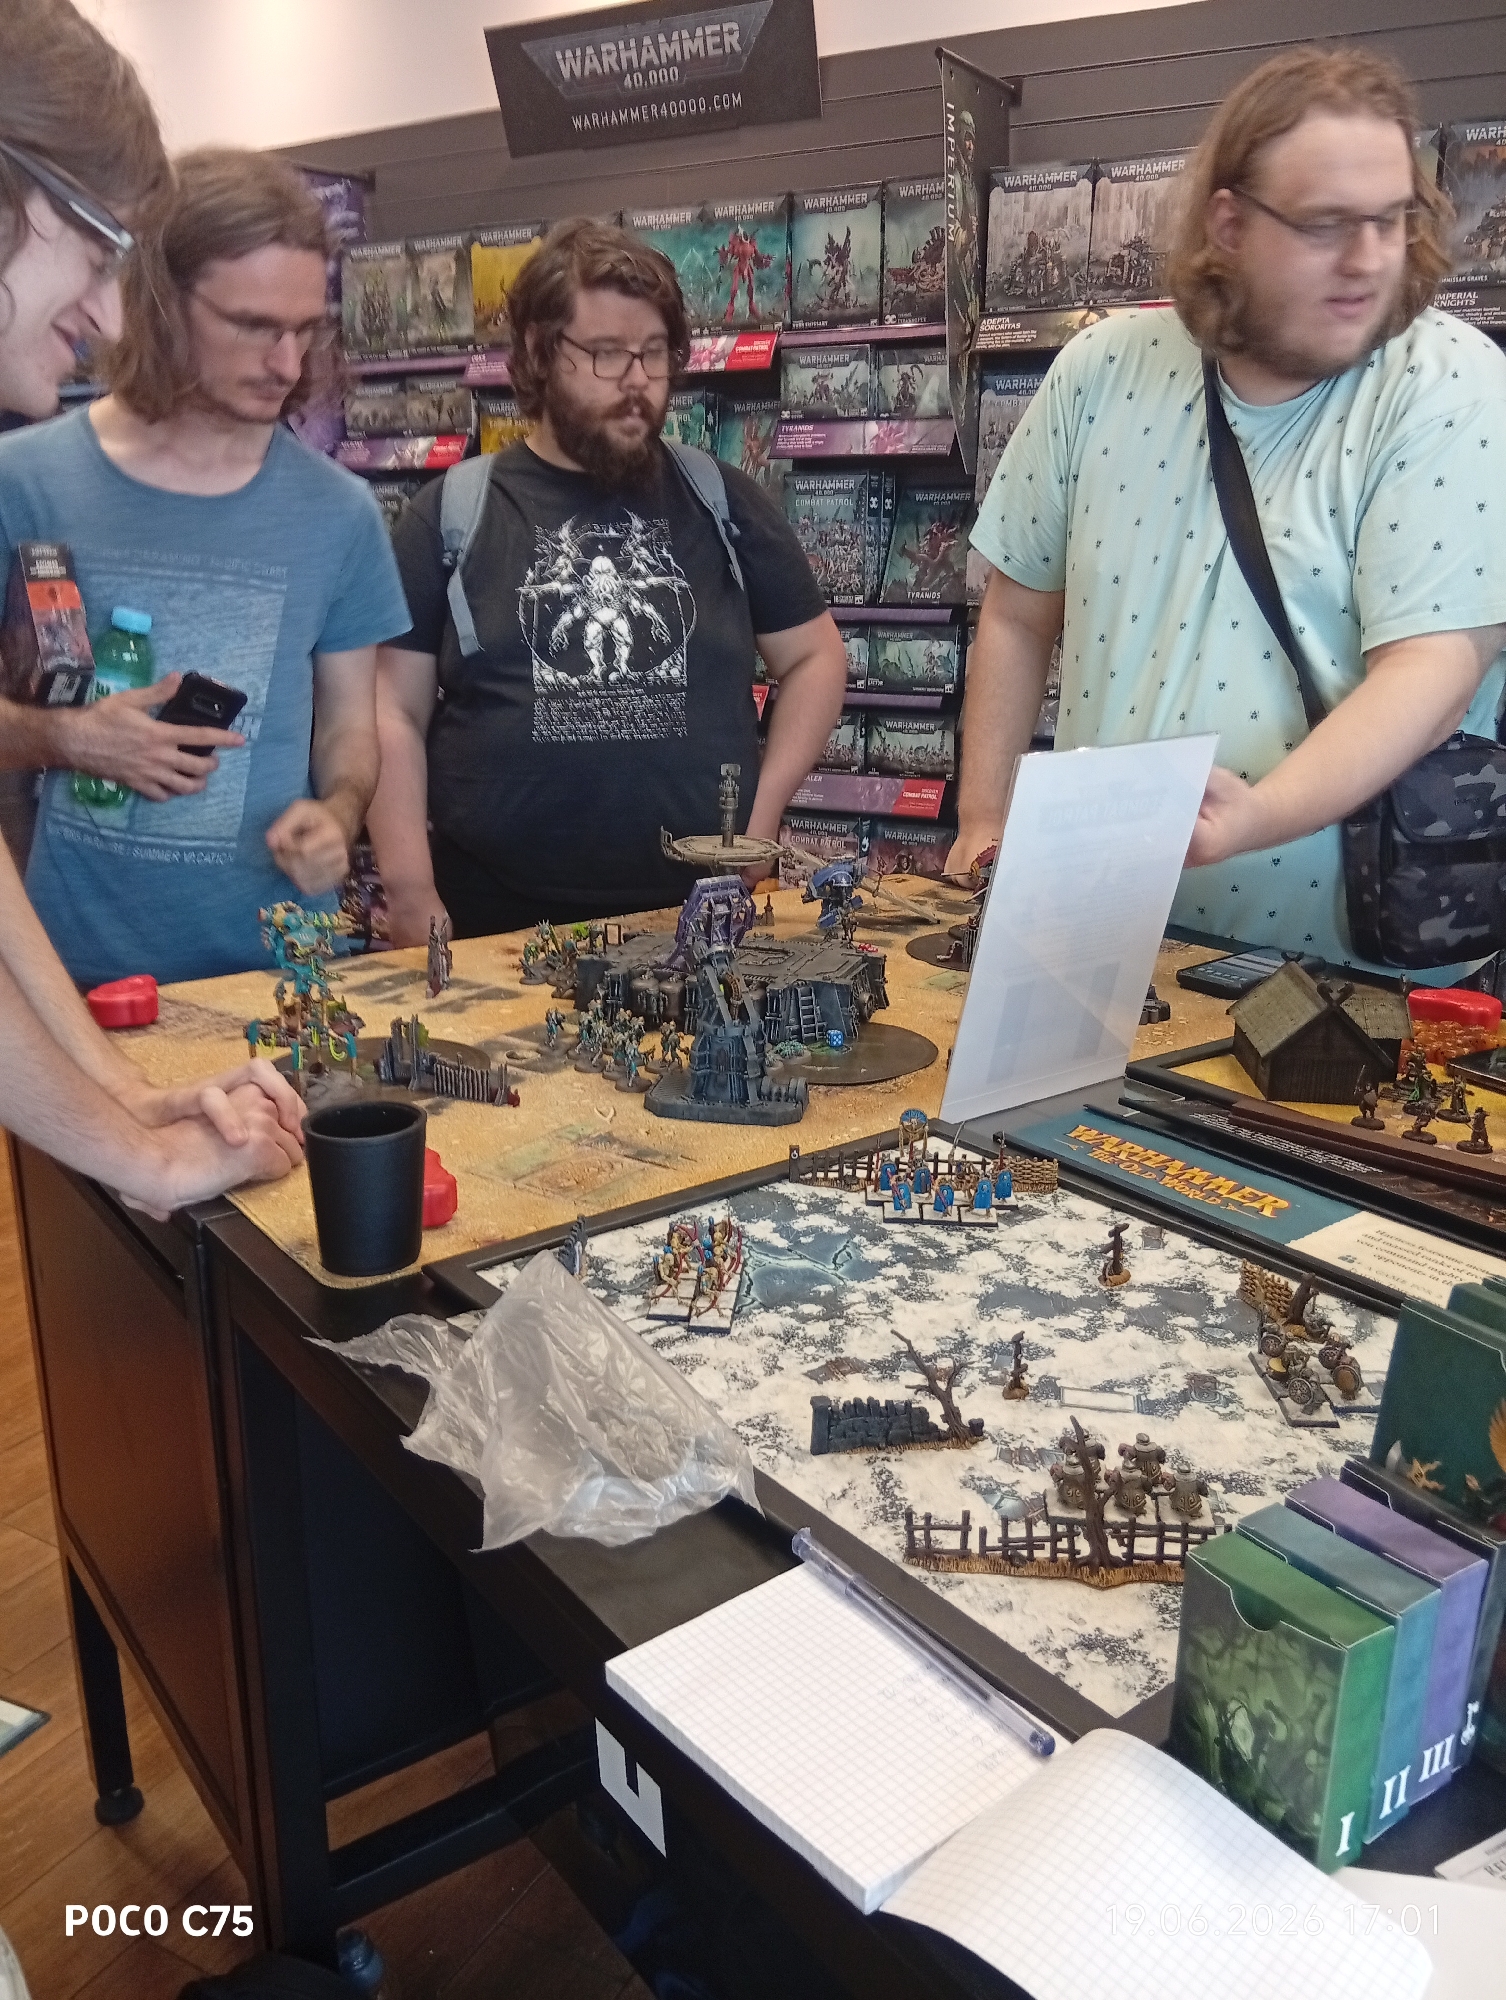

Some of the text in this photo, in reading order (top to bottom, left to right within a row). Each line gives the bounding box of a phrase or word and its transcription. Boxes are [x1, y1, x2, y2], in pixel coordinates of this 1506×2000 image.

[555, 21, 743, 81] WARHAMMER
[572, 92, 743, 132] WARHAMMER40000.COM
[946, 102, 956, 243] IMPERIUM
[1111, 160, 1186, 178] WARHAMMER
[1004, 171, 1078, 188] WARHAMMER
[804, 193, 868, 210] WARHAMMER
[714, 201, 775, 219] WARHAMMER
[632, 212, 692, 228] WARHAMMER
[480, 228, 532, 243] WARHAMMER
[1433, 299, 1476, 307] KNIGHTS
[1434, 292, 1479, 301] IMPERIAL
[979, 323, 1021, 332] SORORITAS
[981, 317, 1010, 326] ADEPTA
[800, 354, 850, 365] WARHAMMER
[781, 424, 814, 433] TYRANIDS
[795, 479, 855, 490] WARHAMMER
[795, 498, 854, 507] COMBAT PATROL
[915, 492, 971, 502] WARHAMMER
[907, 591, 941, 599] TYRANIDS
[877, 631, 914, 639] WARHAMMER
[886, 720, 935, 731] WARHAMMER
[791, 819, 848, 833] WARHAMMER
[884, 830, 937, 843] WARHAMMER
[1066, 1124, 1291, 1218] WARHAMMER
[1087, 1149, 1222, 1206] THE OLD WORLD
[1418, 1733, 1456, 1783] III
[1379, 1764, 1412, 1820] II
[1335, 1811, 1356, 1857] I
